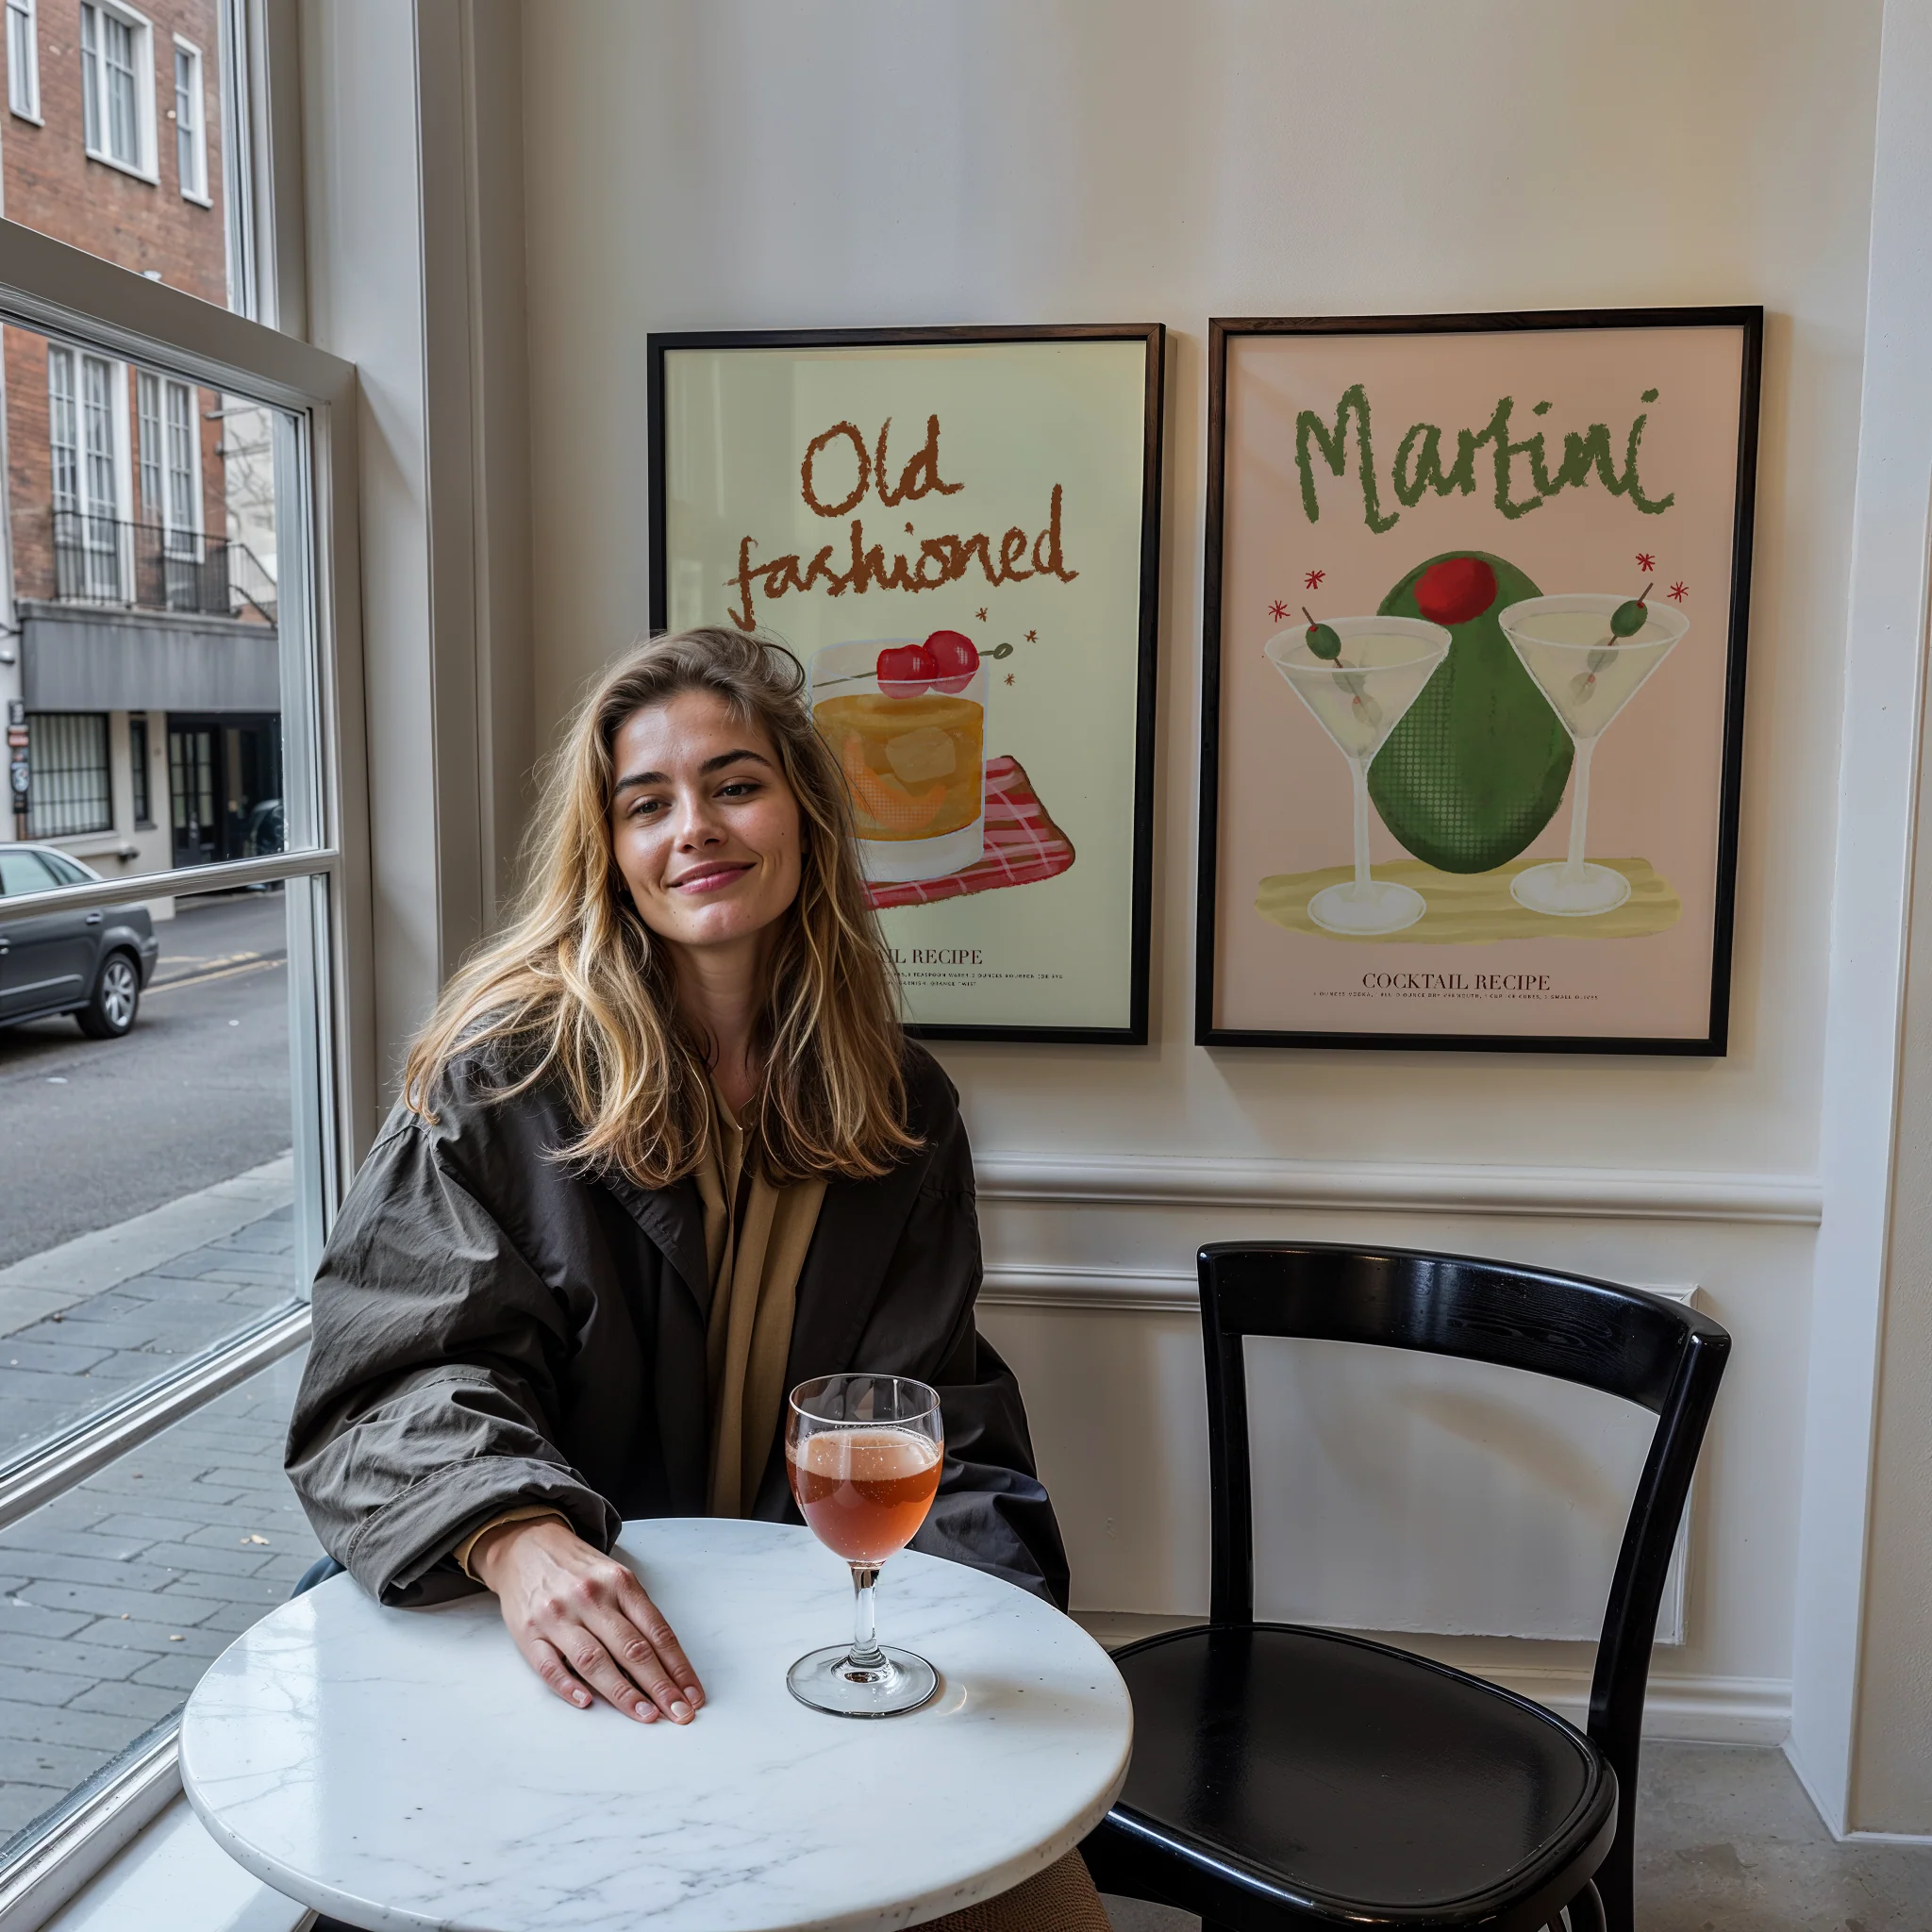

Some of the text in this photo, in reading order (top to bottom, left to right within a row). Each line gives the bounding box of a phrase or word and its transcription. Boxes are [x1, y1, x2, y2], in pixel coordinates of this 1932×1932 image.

[801, 414, 964, 517] Old
[1294, 383, 1674, 534] Martini
[722, 483, 1079, 632] fashioned
[911, 949, 983, 964] RECIPE
[1362, 973, 1550, 991] COCKTAIL RECIPE
